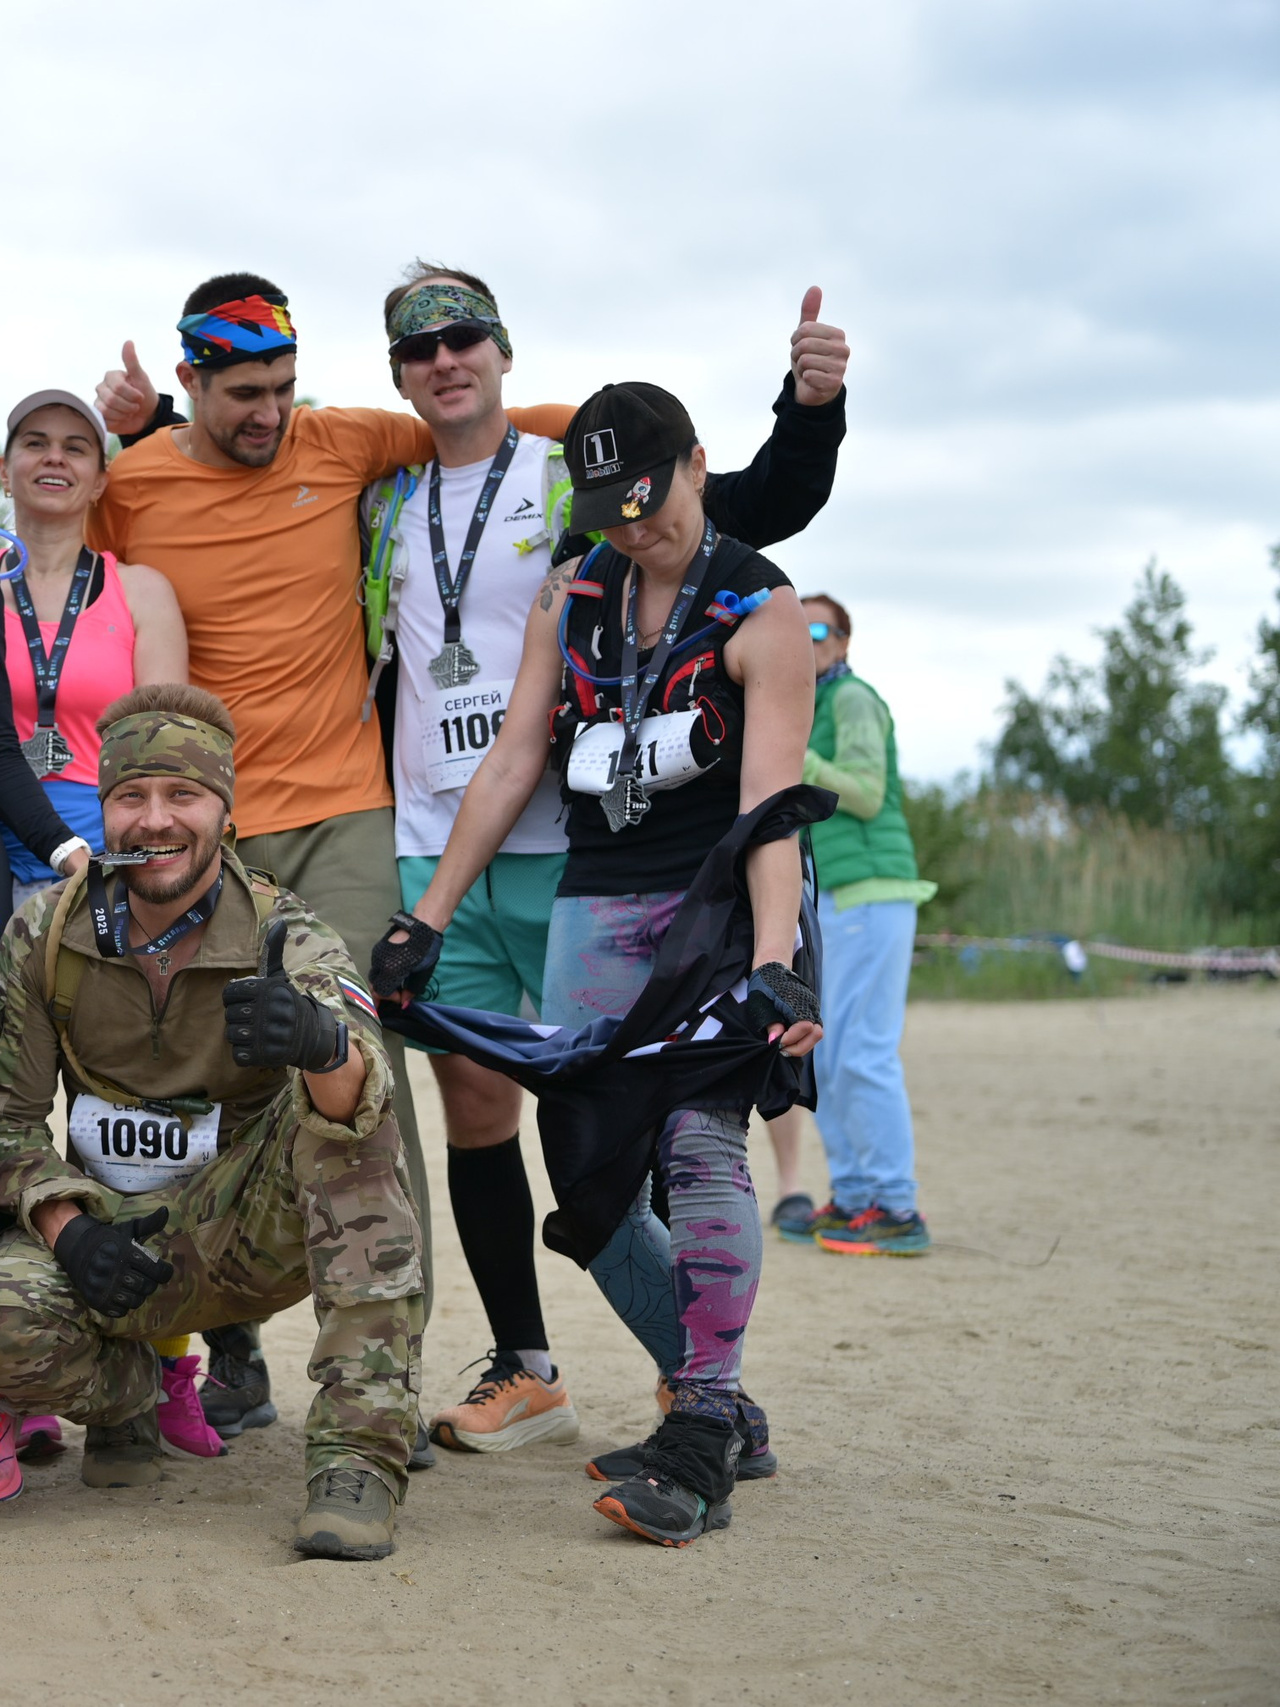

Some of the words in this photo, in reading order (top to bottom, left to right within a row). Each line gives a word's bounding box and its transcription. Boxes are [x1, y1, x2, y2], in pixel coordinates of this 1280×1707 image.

[504, 513, 544, 522] DEMIX
[444, 690, 502, 712] СЕРГЕЙ
[95, 908, 109, 935] 2025
[97, 1117, 189, 1161] 1090
